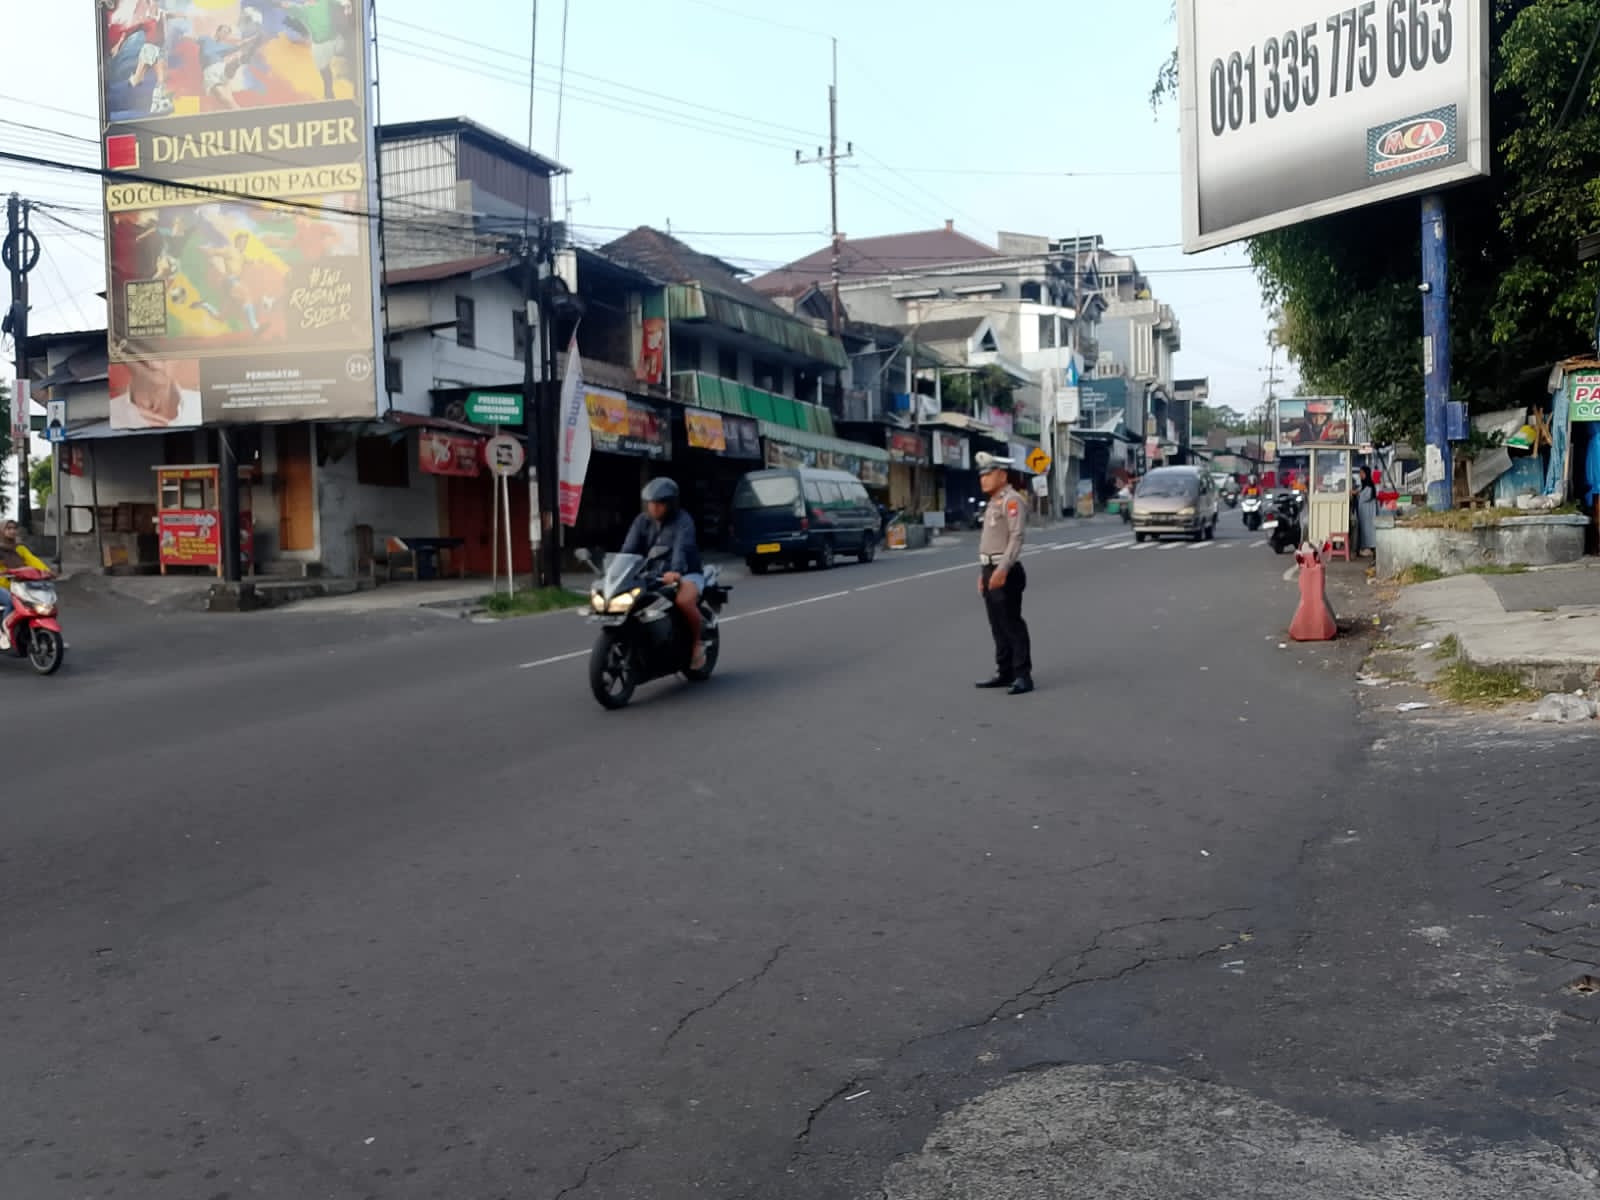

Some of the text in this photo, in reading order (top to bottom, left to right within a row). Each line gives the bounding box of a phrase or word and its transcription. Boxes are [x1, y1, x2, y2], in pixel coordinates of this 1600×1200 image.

[1209, 0, 1453, 137] 081 335 775 663
[152, 117, 358, 163] DJARUM SUPER
[1383, 122, 1438, 154] MCA
[111, 166, 358, 207] SOCCER EDITION PACKS
